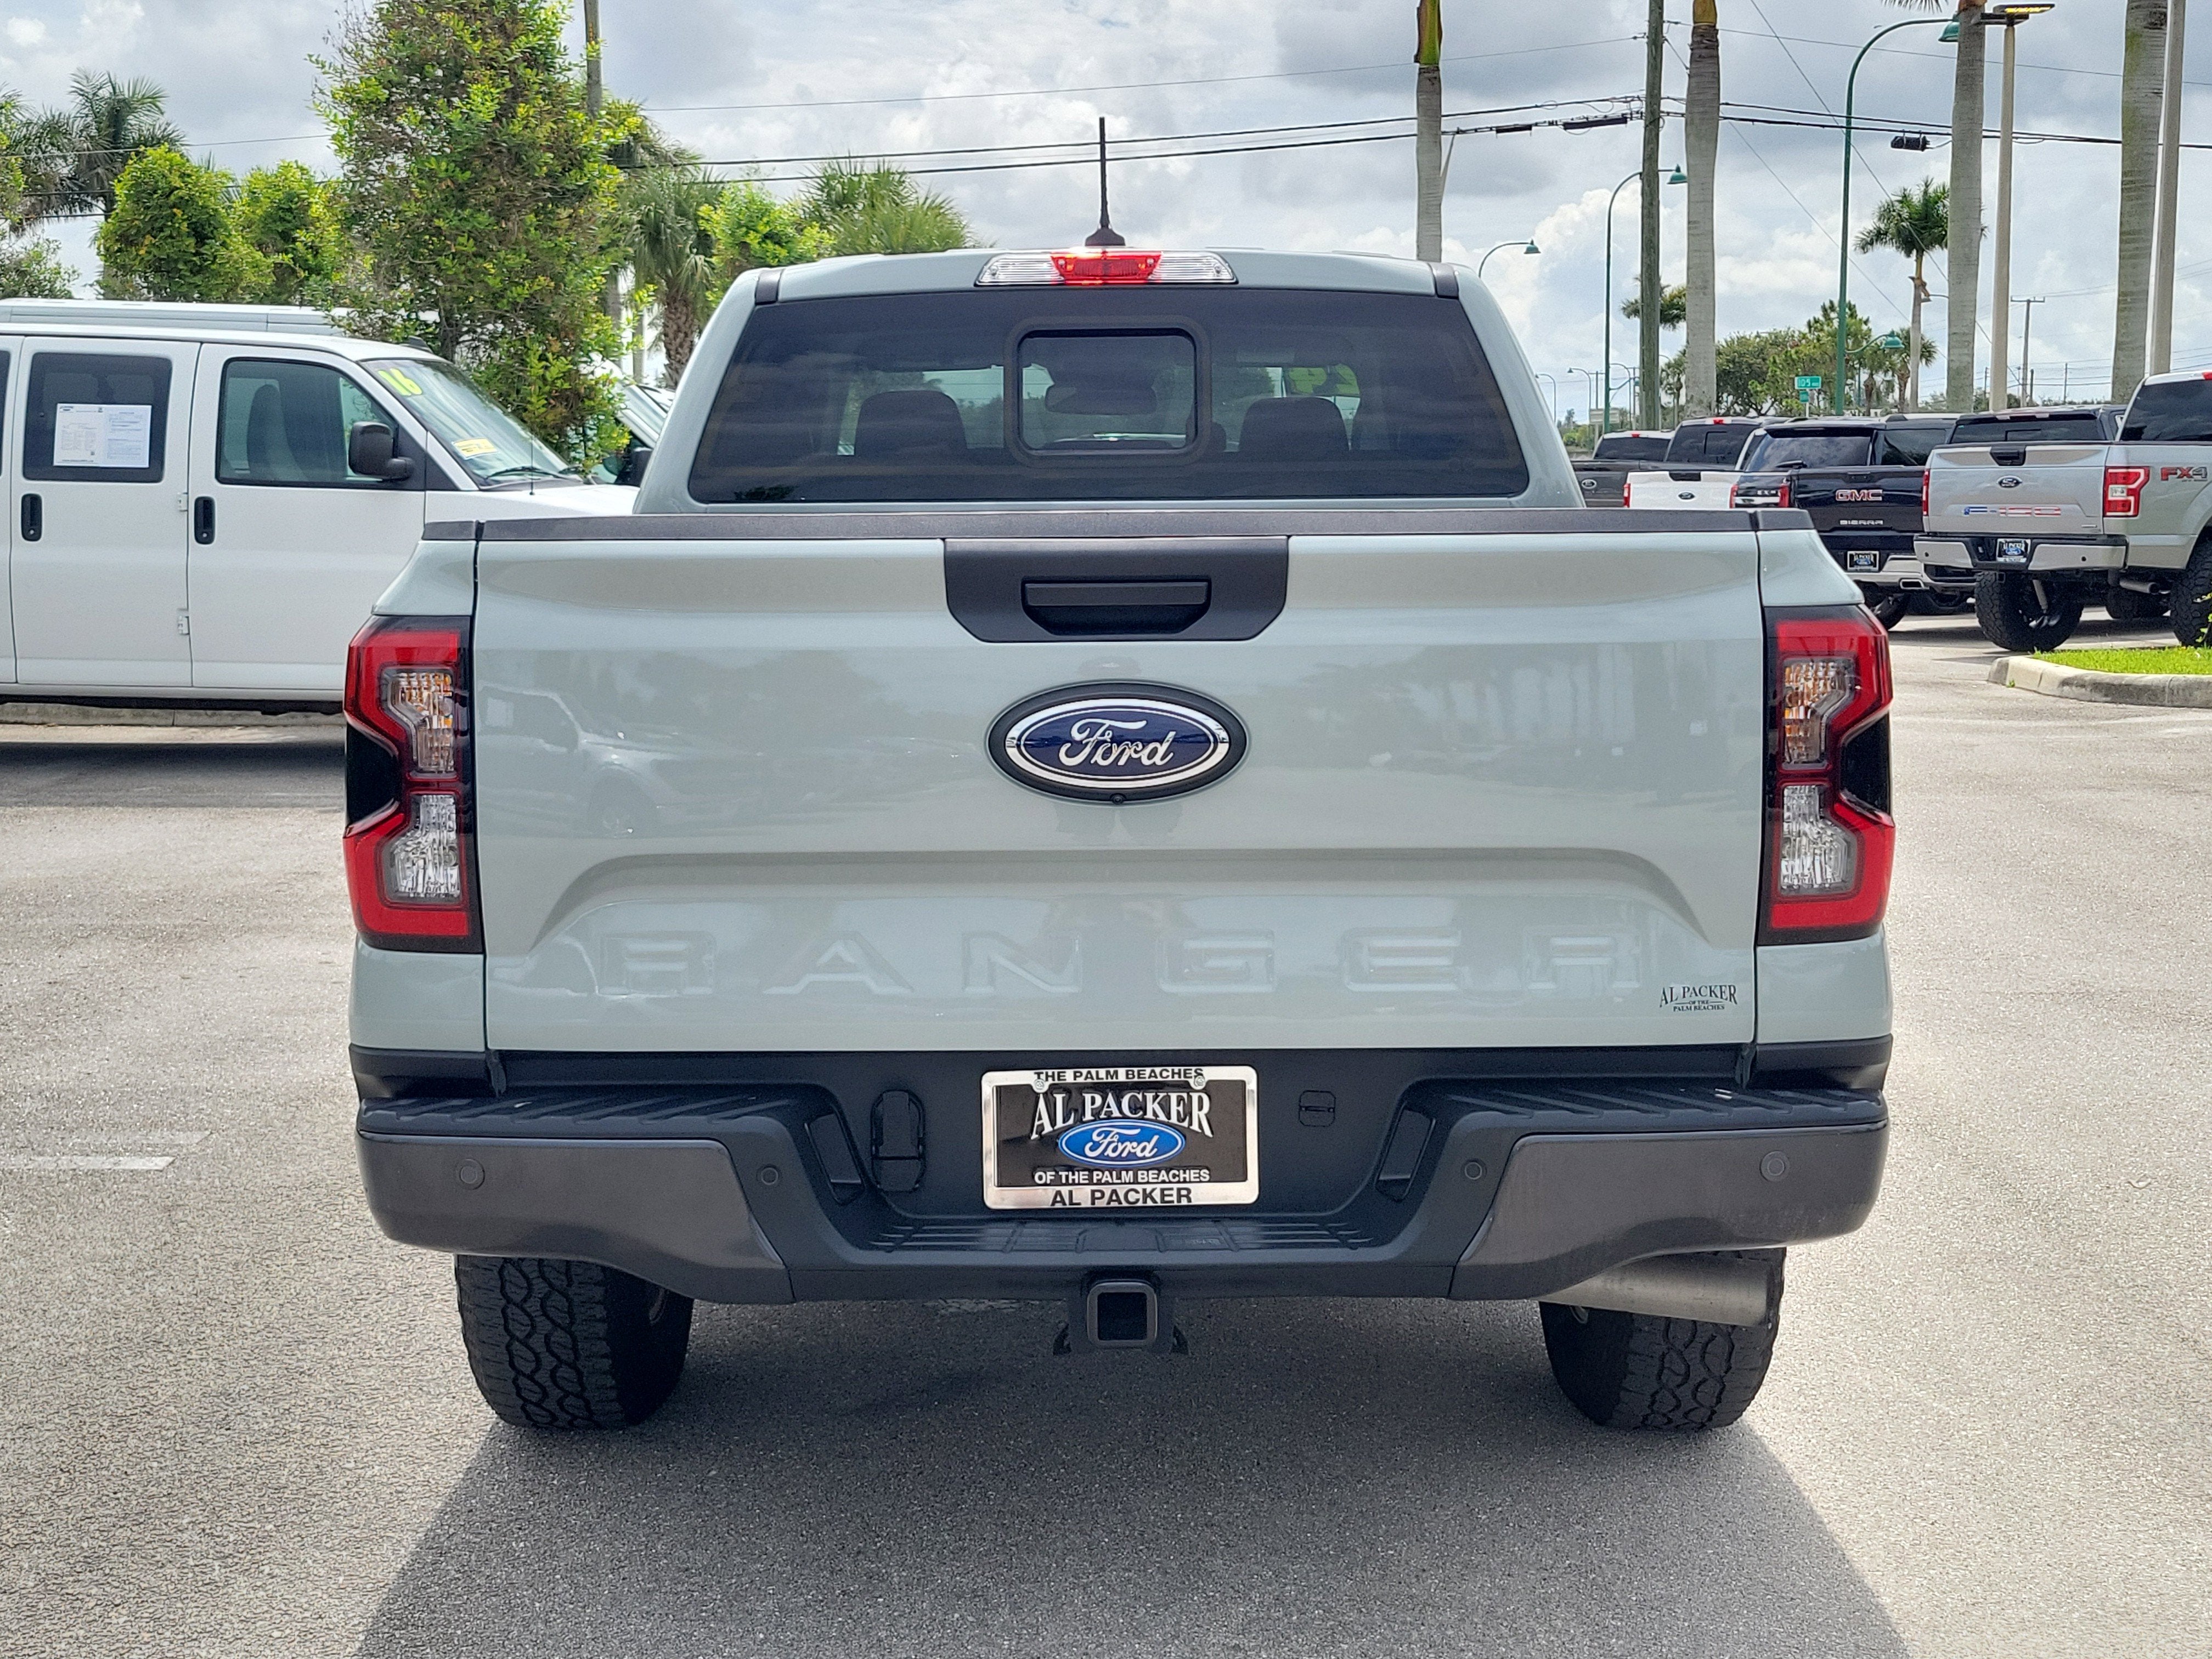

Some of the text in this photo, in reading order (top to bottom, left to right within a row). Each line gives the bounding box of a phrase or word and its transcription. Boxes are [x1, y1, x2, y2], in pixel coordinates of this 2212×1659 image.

[378, 368, 422, 396] 16
[2160, 467, 2208, 481] FX4
[1835, 489, 1883, 501] GMC
[1058, 718, 1177, 766] Ford
[598, 926, 1640, 995] RANGER
[1660, 985, 1737, 1008] AL PACKER
[1034, 1068, 1204, 1082] THE PALM BEACHES
[1030, 1092, 1214, 1140] AL PACKER
[1084, 1127, 1160, 1158] Ford
[1034, 1169, 1210, 1184] OF THE PALM BEACHES
[1050, 1187, 1192, 1206] AL PACKER
